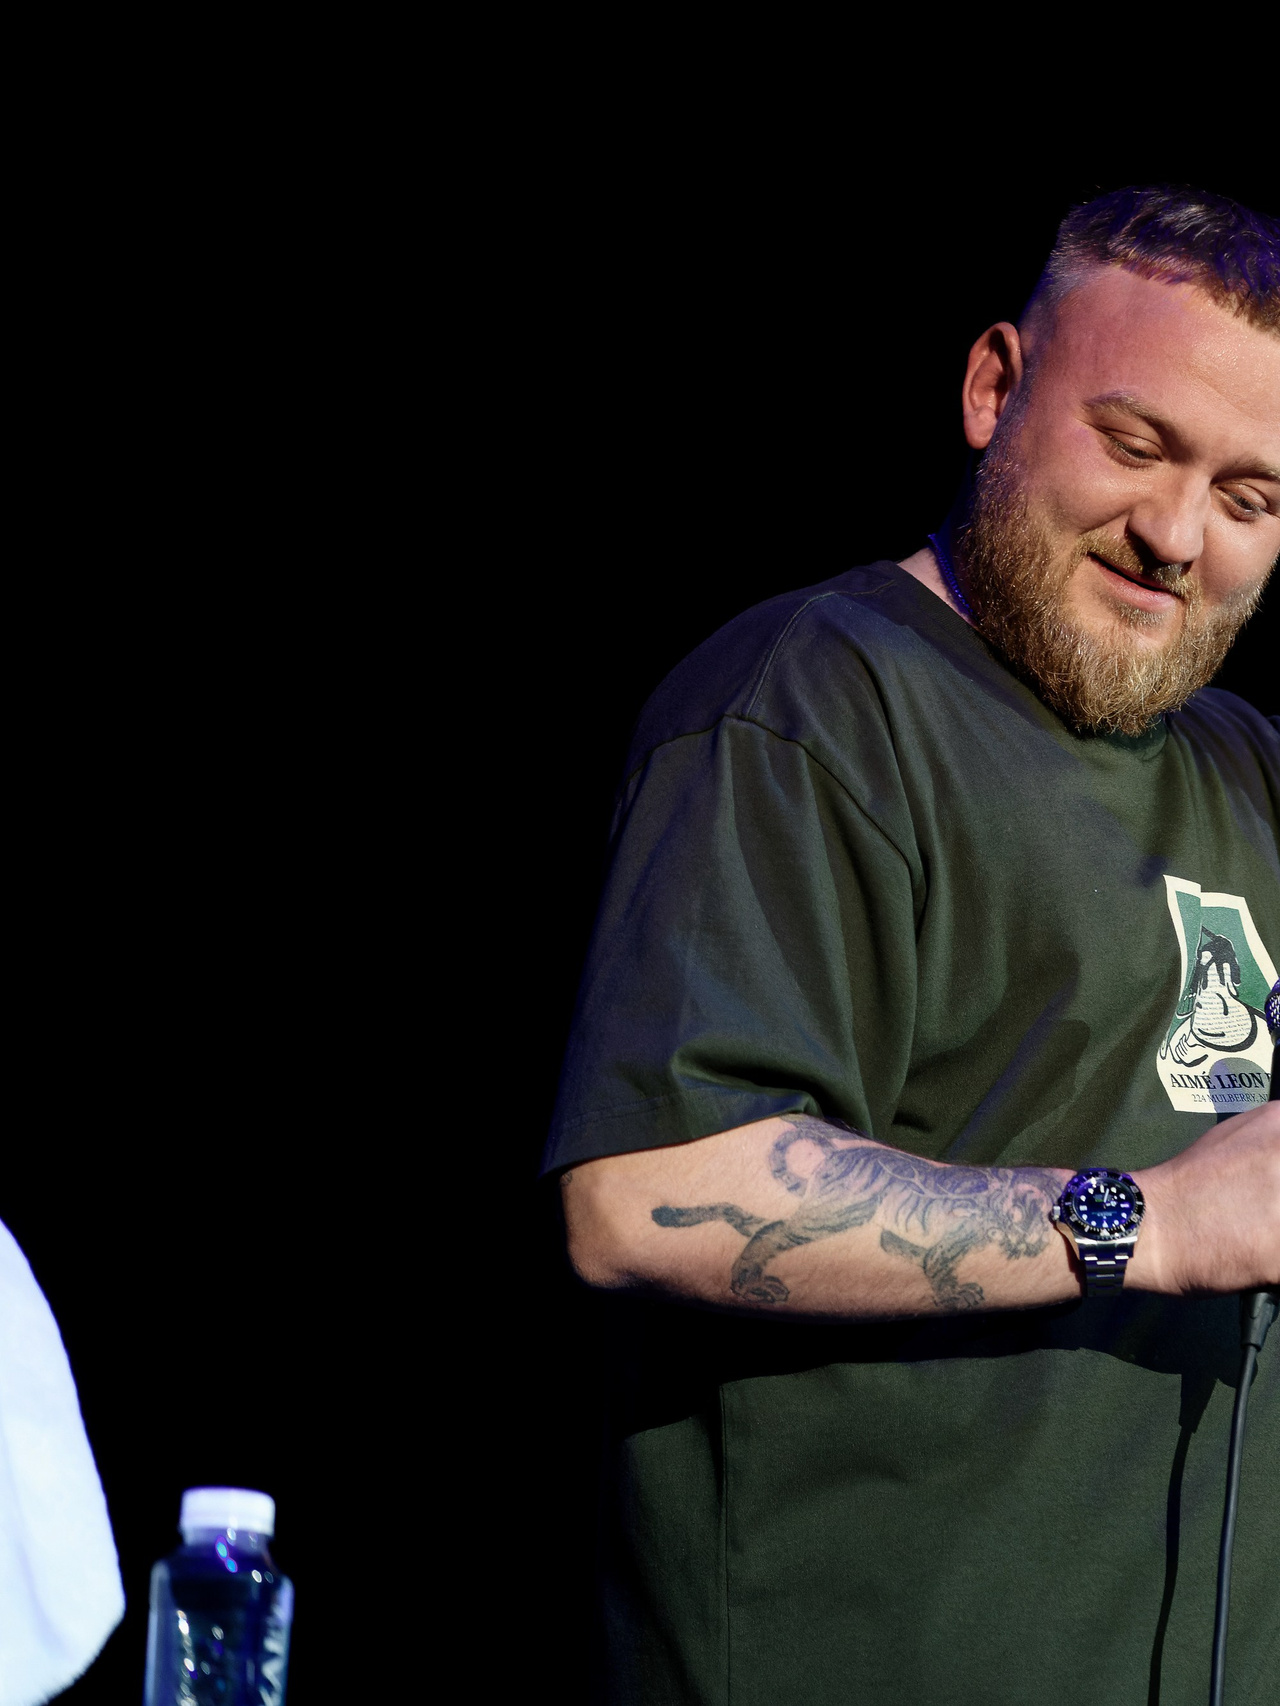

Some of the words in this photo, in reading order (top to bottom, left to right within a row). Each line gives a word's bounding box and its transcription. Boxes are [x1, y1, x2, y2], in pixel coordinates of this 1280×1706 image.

[1170, 1070, 1216, 1089] AIMÉ
[1214, 1072, 1265, 1089] LEON
[1191, 1093, 1206, 1103] 224
[1207, 1093, 1258, 1103] MULBERRY,
